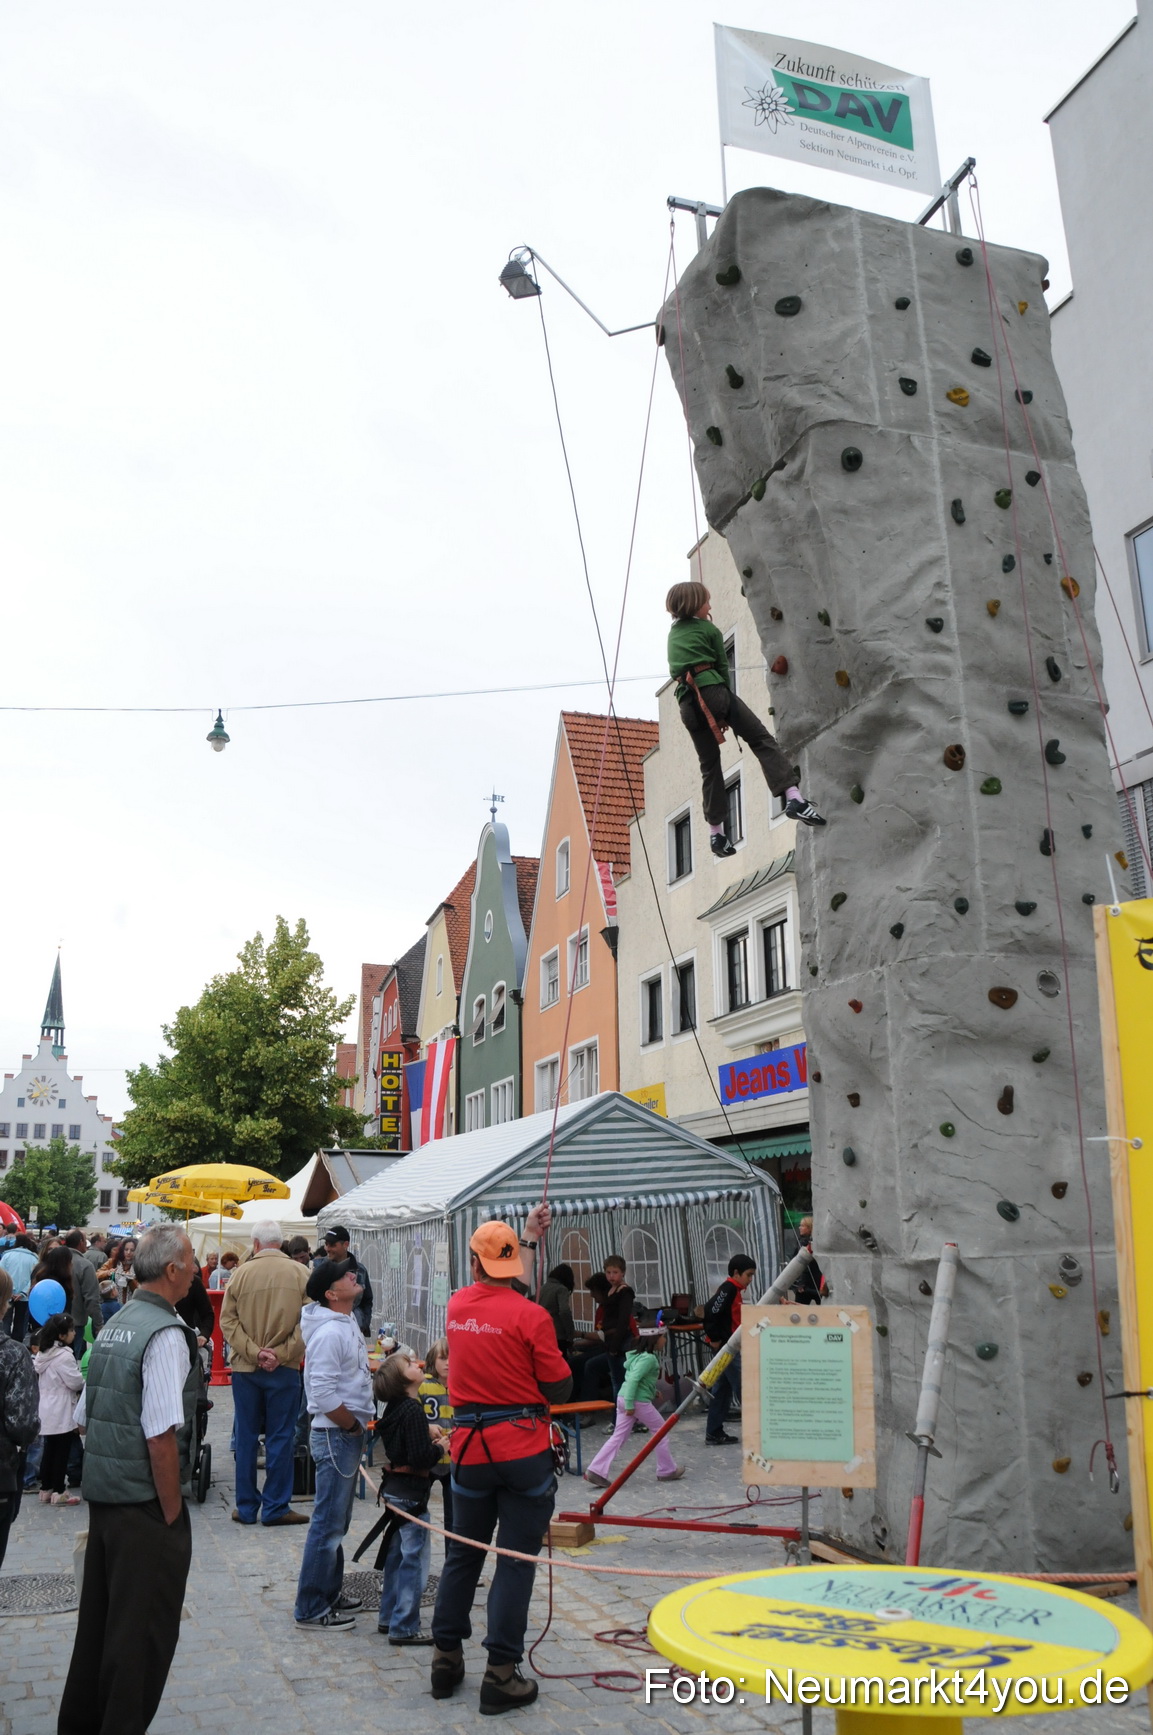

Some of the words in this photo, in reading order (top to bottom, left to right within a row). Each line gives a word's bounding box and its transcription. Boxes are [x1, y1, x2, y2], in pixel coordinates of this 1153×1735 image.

[774, 52, 836, 83] Zukunft
[840, 72, 905, 91] schützen
[791, 81, 903, 134] DAV
[800, 122, 845, 142] Deutscher
[847, 135, 898, 159] Alpenverein
[899, 154, 917, 164] e.V.
[800, 139, 834, 156] Sektion
[837, 149, 880, 170] Neumarkt
[898, 167, 919, 181] Opf.
[725, 1061, 791, 1100] Jeans
[828, 1334, 842, 1342] DAV
[425, 1396, 440, 1421] 3
[767, 1608, 886, 1633] Bier
[807, 1579, 1052, 1626] NEUMARKTER
[711, 1627, 1033, 1669] Glossner
